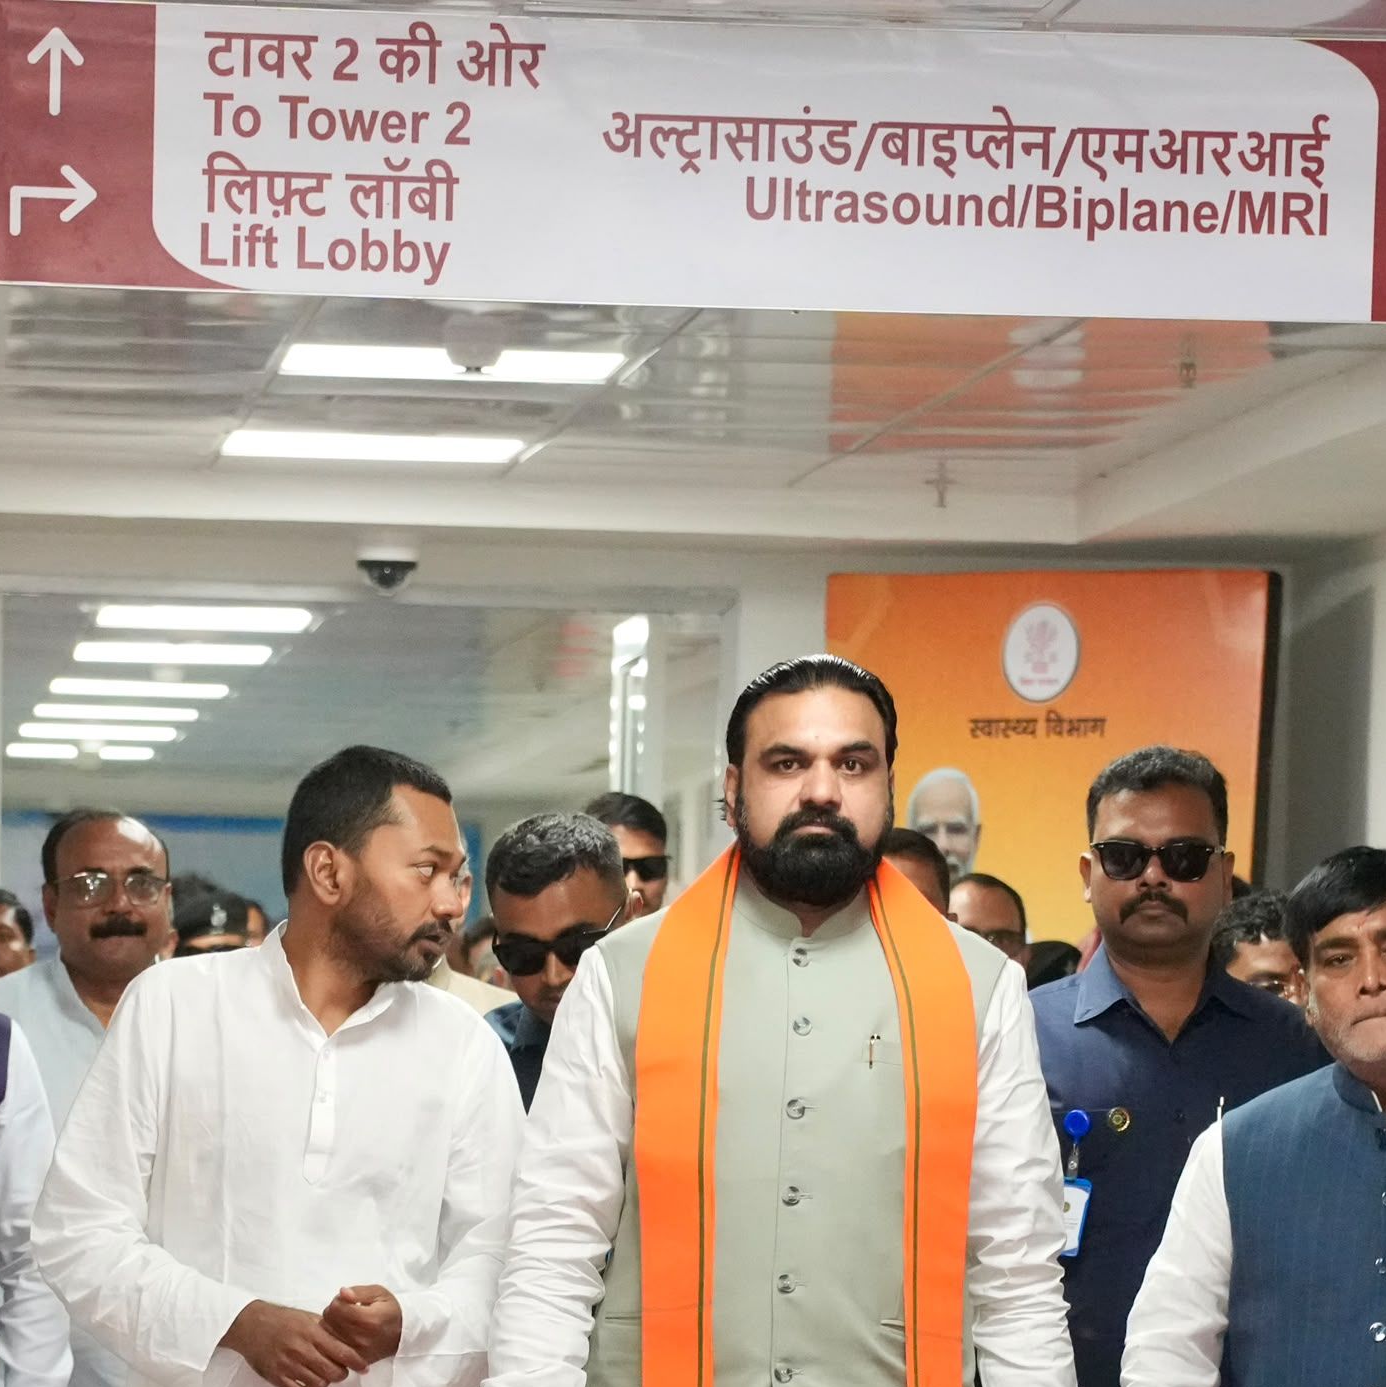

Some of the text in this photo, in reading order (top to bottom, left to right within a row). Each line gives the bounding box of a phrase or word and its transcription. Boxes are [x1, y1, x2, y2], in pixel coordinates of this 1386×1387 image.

[205, 21, 546, 89] टावर 2 की ओर
[203, 92, 472, 146] To Tower 2
[602, 105, 1332, 187] अल्ट्रासाउंड/बाइप्लेन/एमआरआई
[345, 157, 460, 222] लॉबी
[744, 176, 1330, 242] Ultrasound/Biplane/MRI
[199, 223, 451, 286] Lift Lobby
[1044, 709, 1106, 739] विभाग
